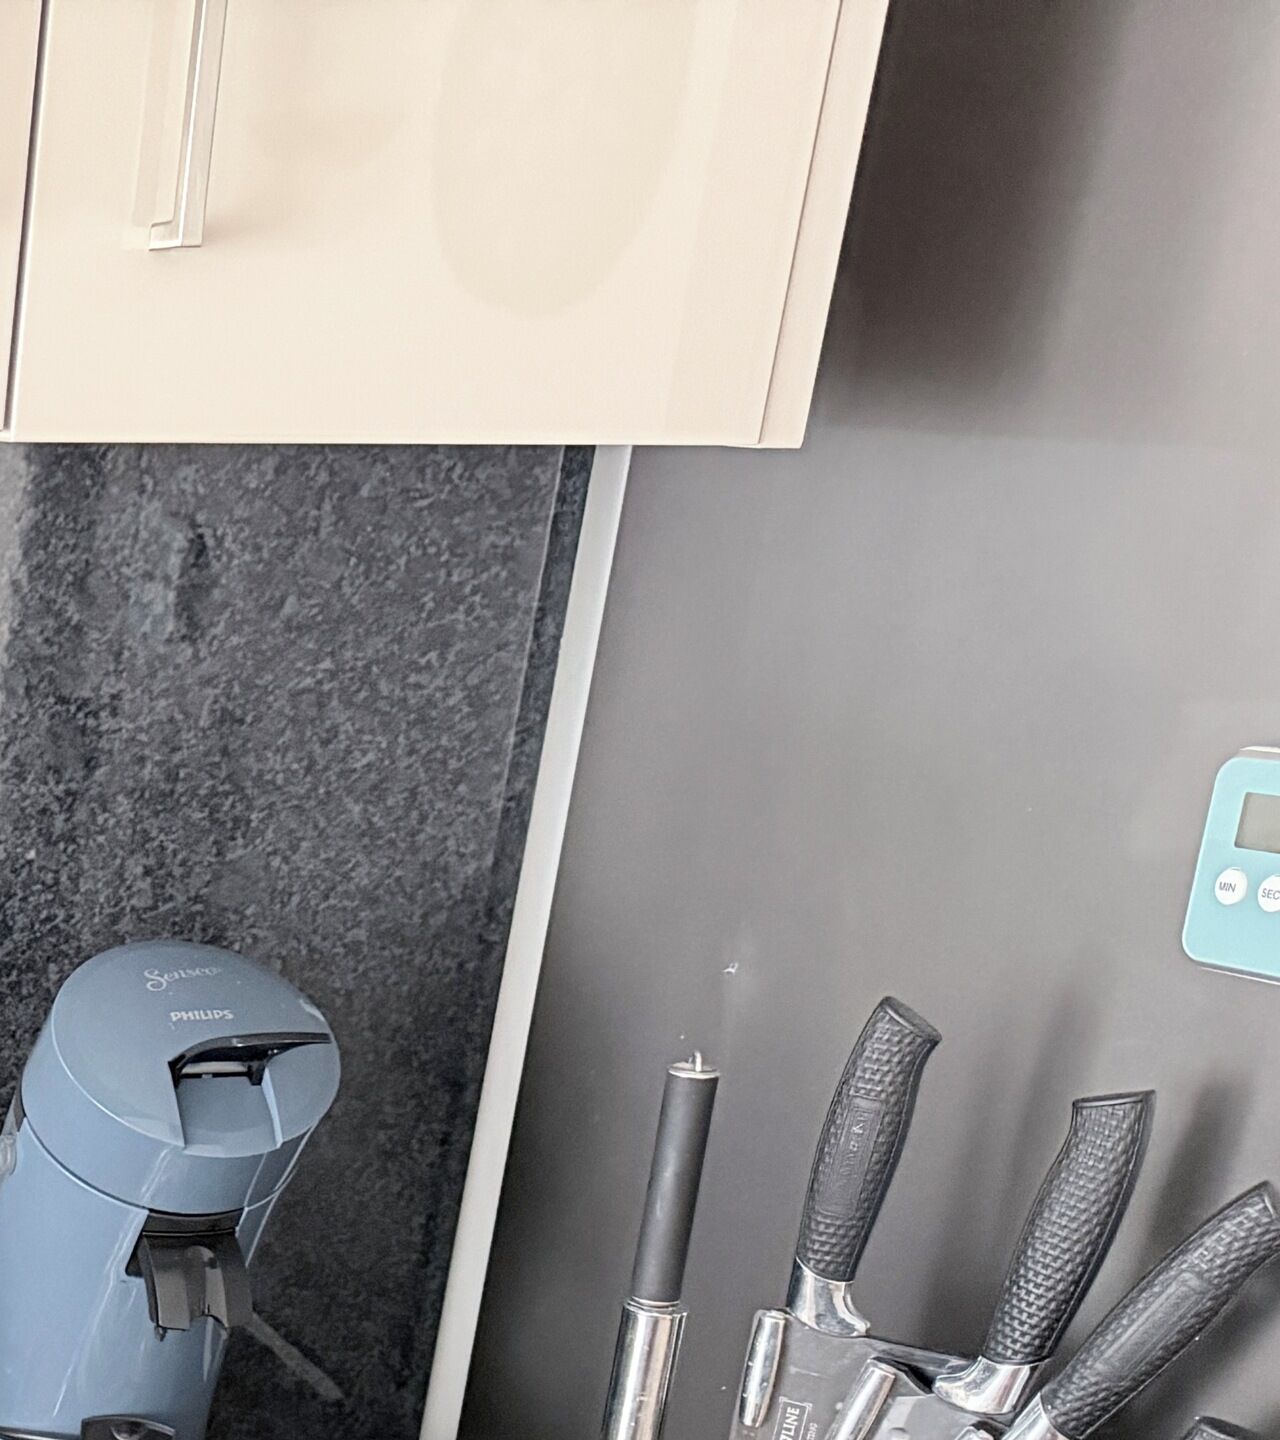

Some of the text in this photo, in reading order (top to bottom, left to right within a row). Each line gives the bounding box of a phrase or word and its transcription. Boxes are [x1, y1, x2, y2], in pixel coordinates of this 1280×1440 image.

[1219, 881, 1237, 893] MIN
[1261, 887, 1280, 900] SEC
[170, 1009, 234, 1022] PHILIPS
[781, 1406, 800, 1437] LINE
